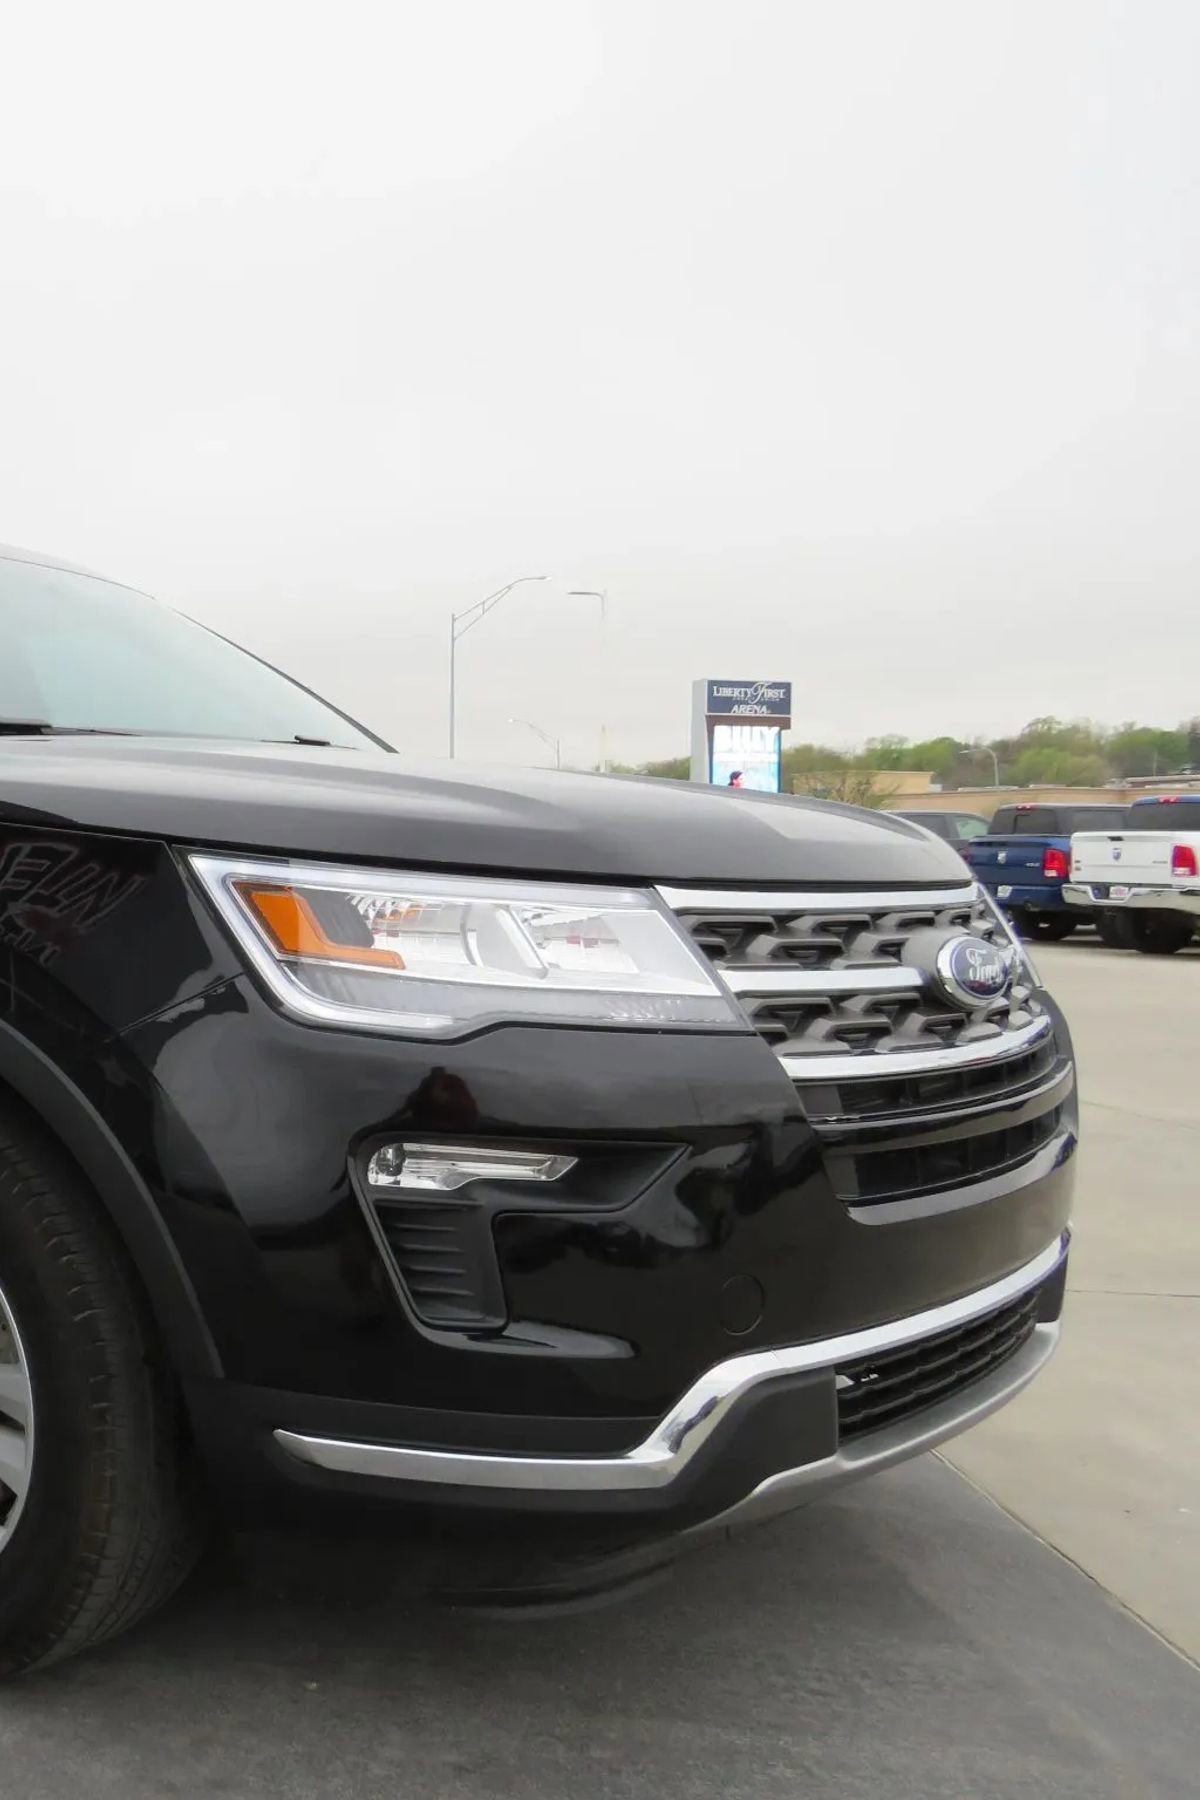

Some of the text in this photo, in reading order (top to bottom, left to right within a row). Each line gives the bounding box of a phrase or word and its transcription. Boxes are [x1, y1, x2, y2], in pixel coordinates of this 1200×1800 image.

[712, 682, 786, 704] LIBERTY FIRST
[730, 704, 768, 714] ARENA
[964, 947, 1004, 984] Ford
